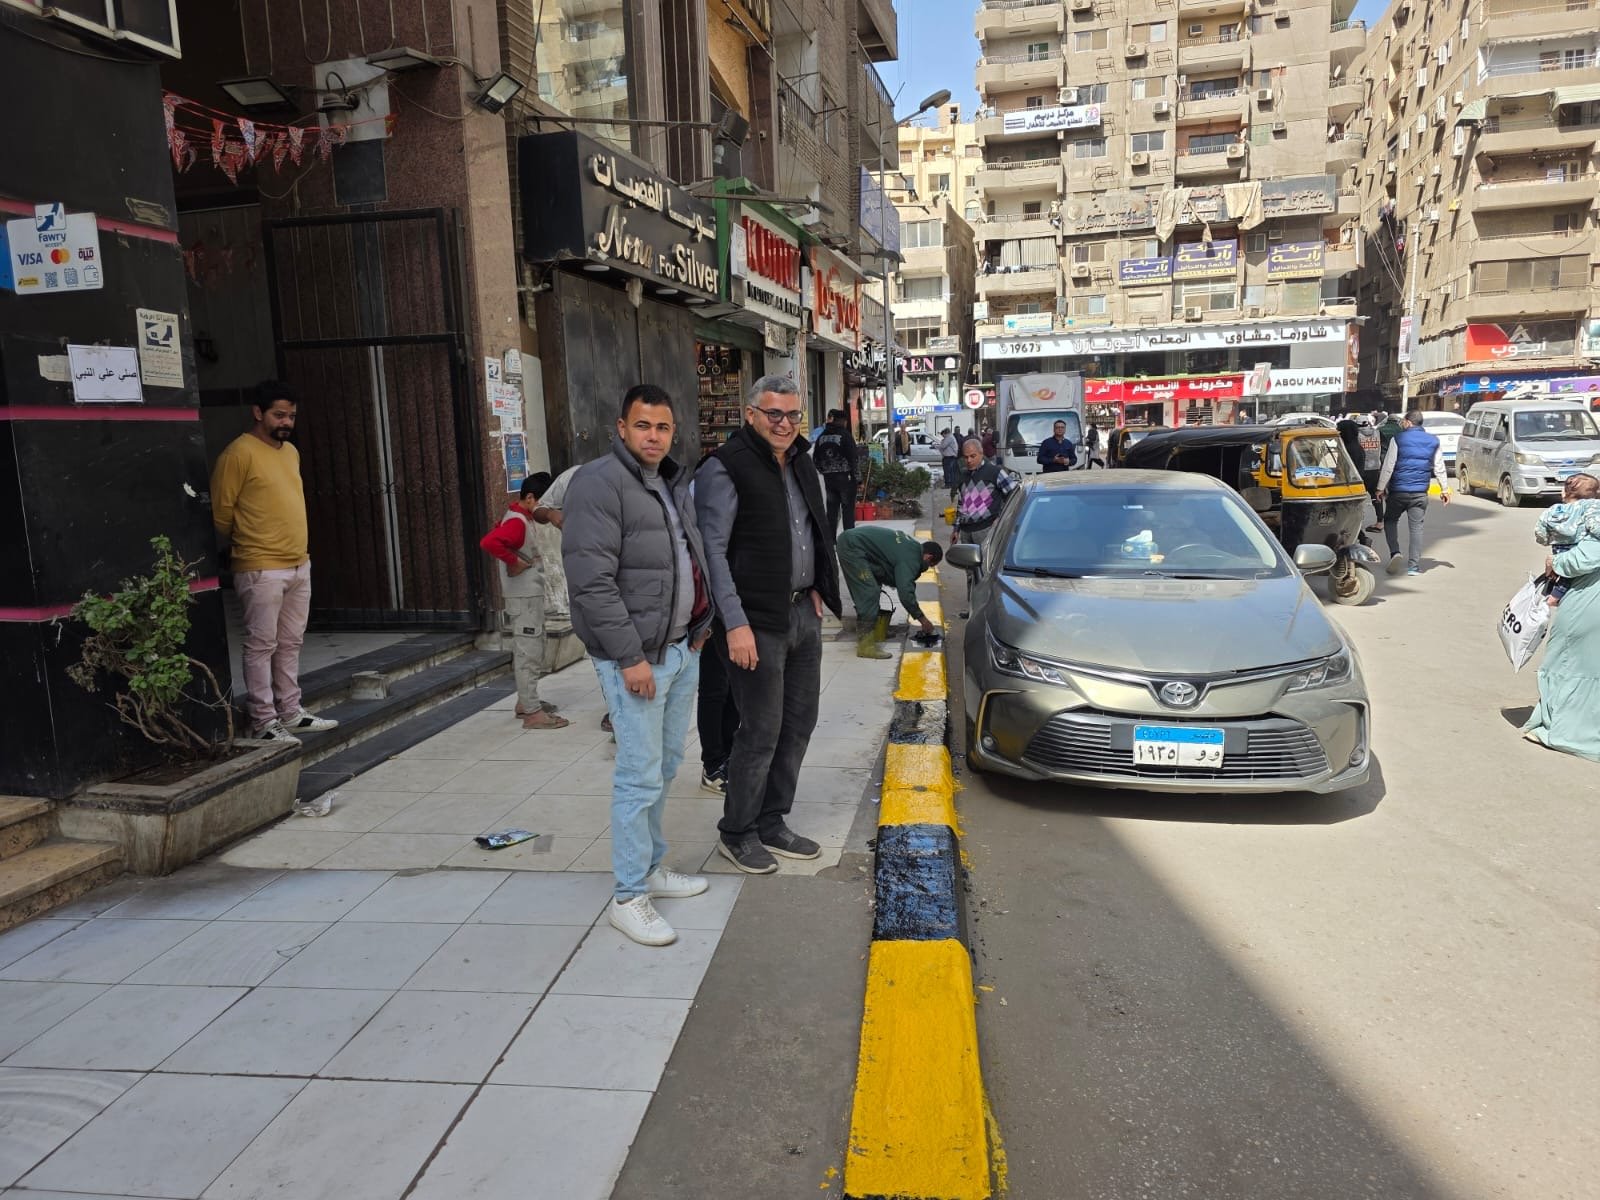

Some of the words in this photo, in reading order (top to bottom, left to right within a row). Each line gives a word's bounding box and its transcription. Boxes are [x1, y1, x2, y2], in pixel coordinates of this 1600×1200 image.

[1057, 108, 1074, 118] مركز
[38, 233, 66, 242] fawry
[18, 253, 43, 265] VISA
[658, 254, 676, 279] For
[676, 243, 718, 294] Silver
[1281, 325, 1327, 340] شاورما
[1149, 331, 1191, 347] المعلم
[75, 368, 95, 381] النبي
[118, 369, 137, 381] صلي
[1189, 380, 1233, 391] مكرونة
[1275, 378, 1303, 387] ABOU
[1306, 376, 1341, 386] MAZEN
